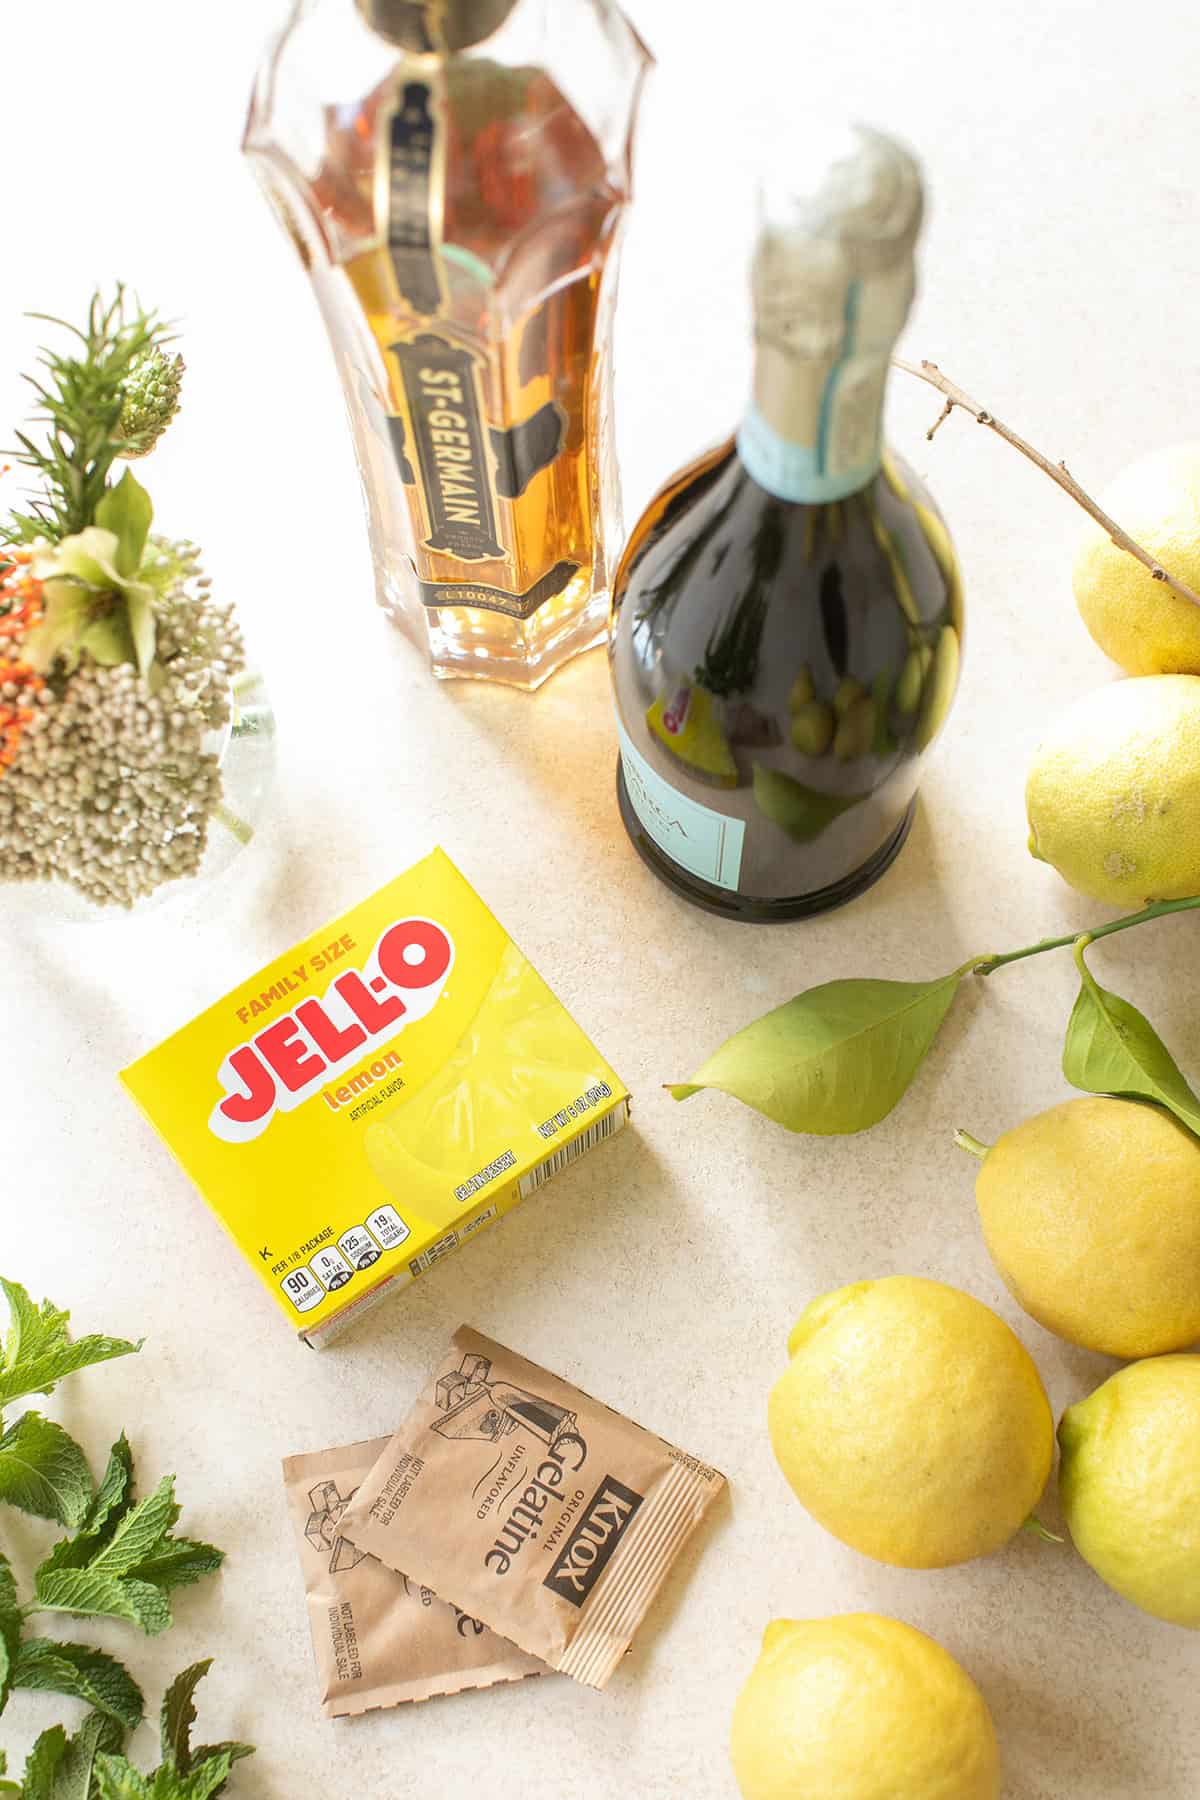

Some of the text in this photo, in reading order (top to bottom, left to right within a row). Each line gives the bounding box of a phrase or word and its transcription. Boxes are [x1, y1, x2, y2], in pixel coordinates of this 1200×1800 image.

[235, 933, 357, 1025] FAMILY SIZE
[218, 919, 452, 1123] JELL-O
[323, 1050, 403, 1110] lemon
[349, 1078, 406, 1121] ARTIFICIAL FLAVOR
[537, 1118, 558, 1139] NET
[555, 1108, 571, 1128] WT
[567, 1105, 578, 1119] 6
[575, 1096, 589, 1114] OZ
[453, 1149, 517, 1202] GELATIN DESSERT
[258, 1246, 273, 1261] K
[271, 1226, 336, 1276] PER 1/8 PACKAGE
[380, 1223, 398, 1238] TOTAL
[286, 1271, 309, 1294] 90
[368, 1453, 414, 1519] INDIVIDUAL SALE
[380, 1456, 425, 1526] NOT LABELED FOR
[476, 1444, 526, 1520] UNFLAVORED
[484, 1431, 588, 1576] Gelatine
[542, 1489, 586, 1551] ORIGINAL
[555, 1488, 633, 1592] Knox
[328, 1606, 350, 1681] INDIVIDUAL SALE
[340, 1601, 363, 1680] NOT LABELED FOR
